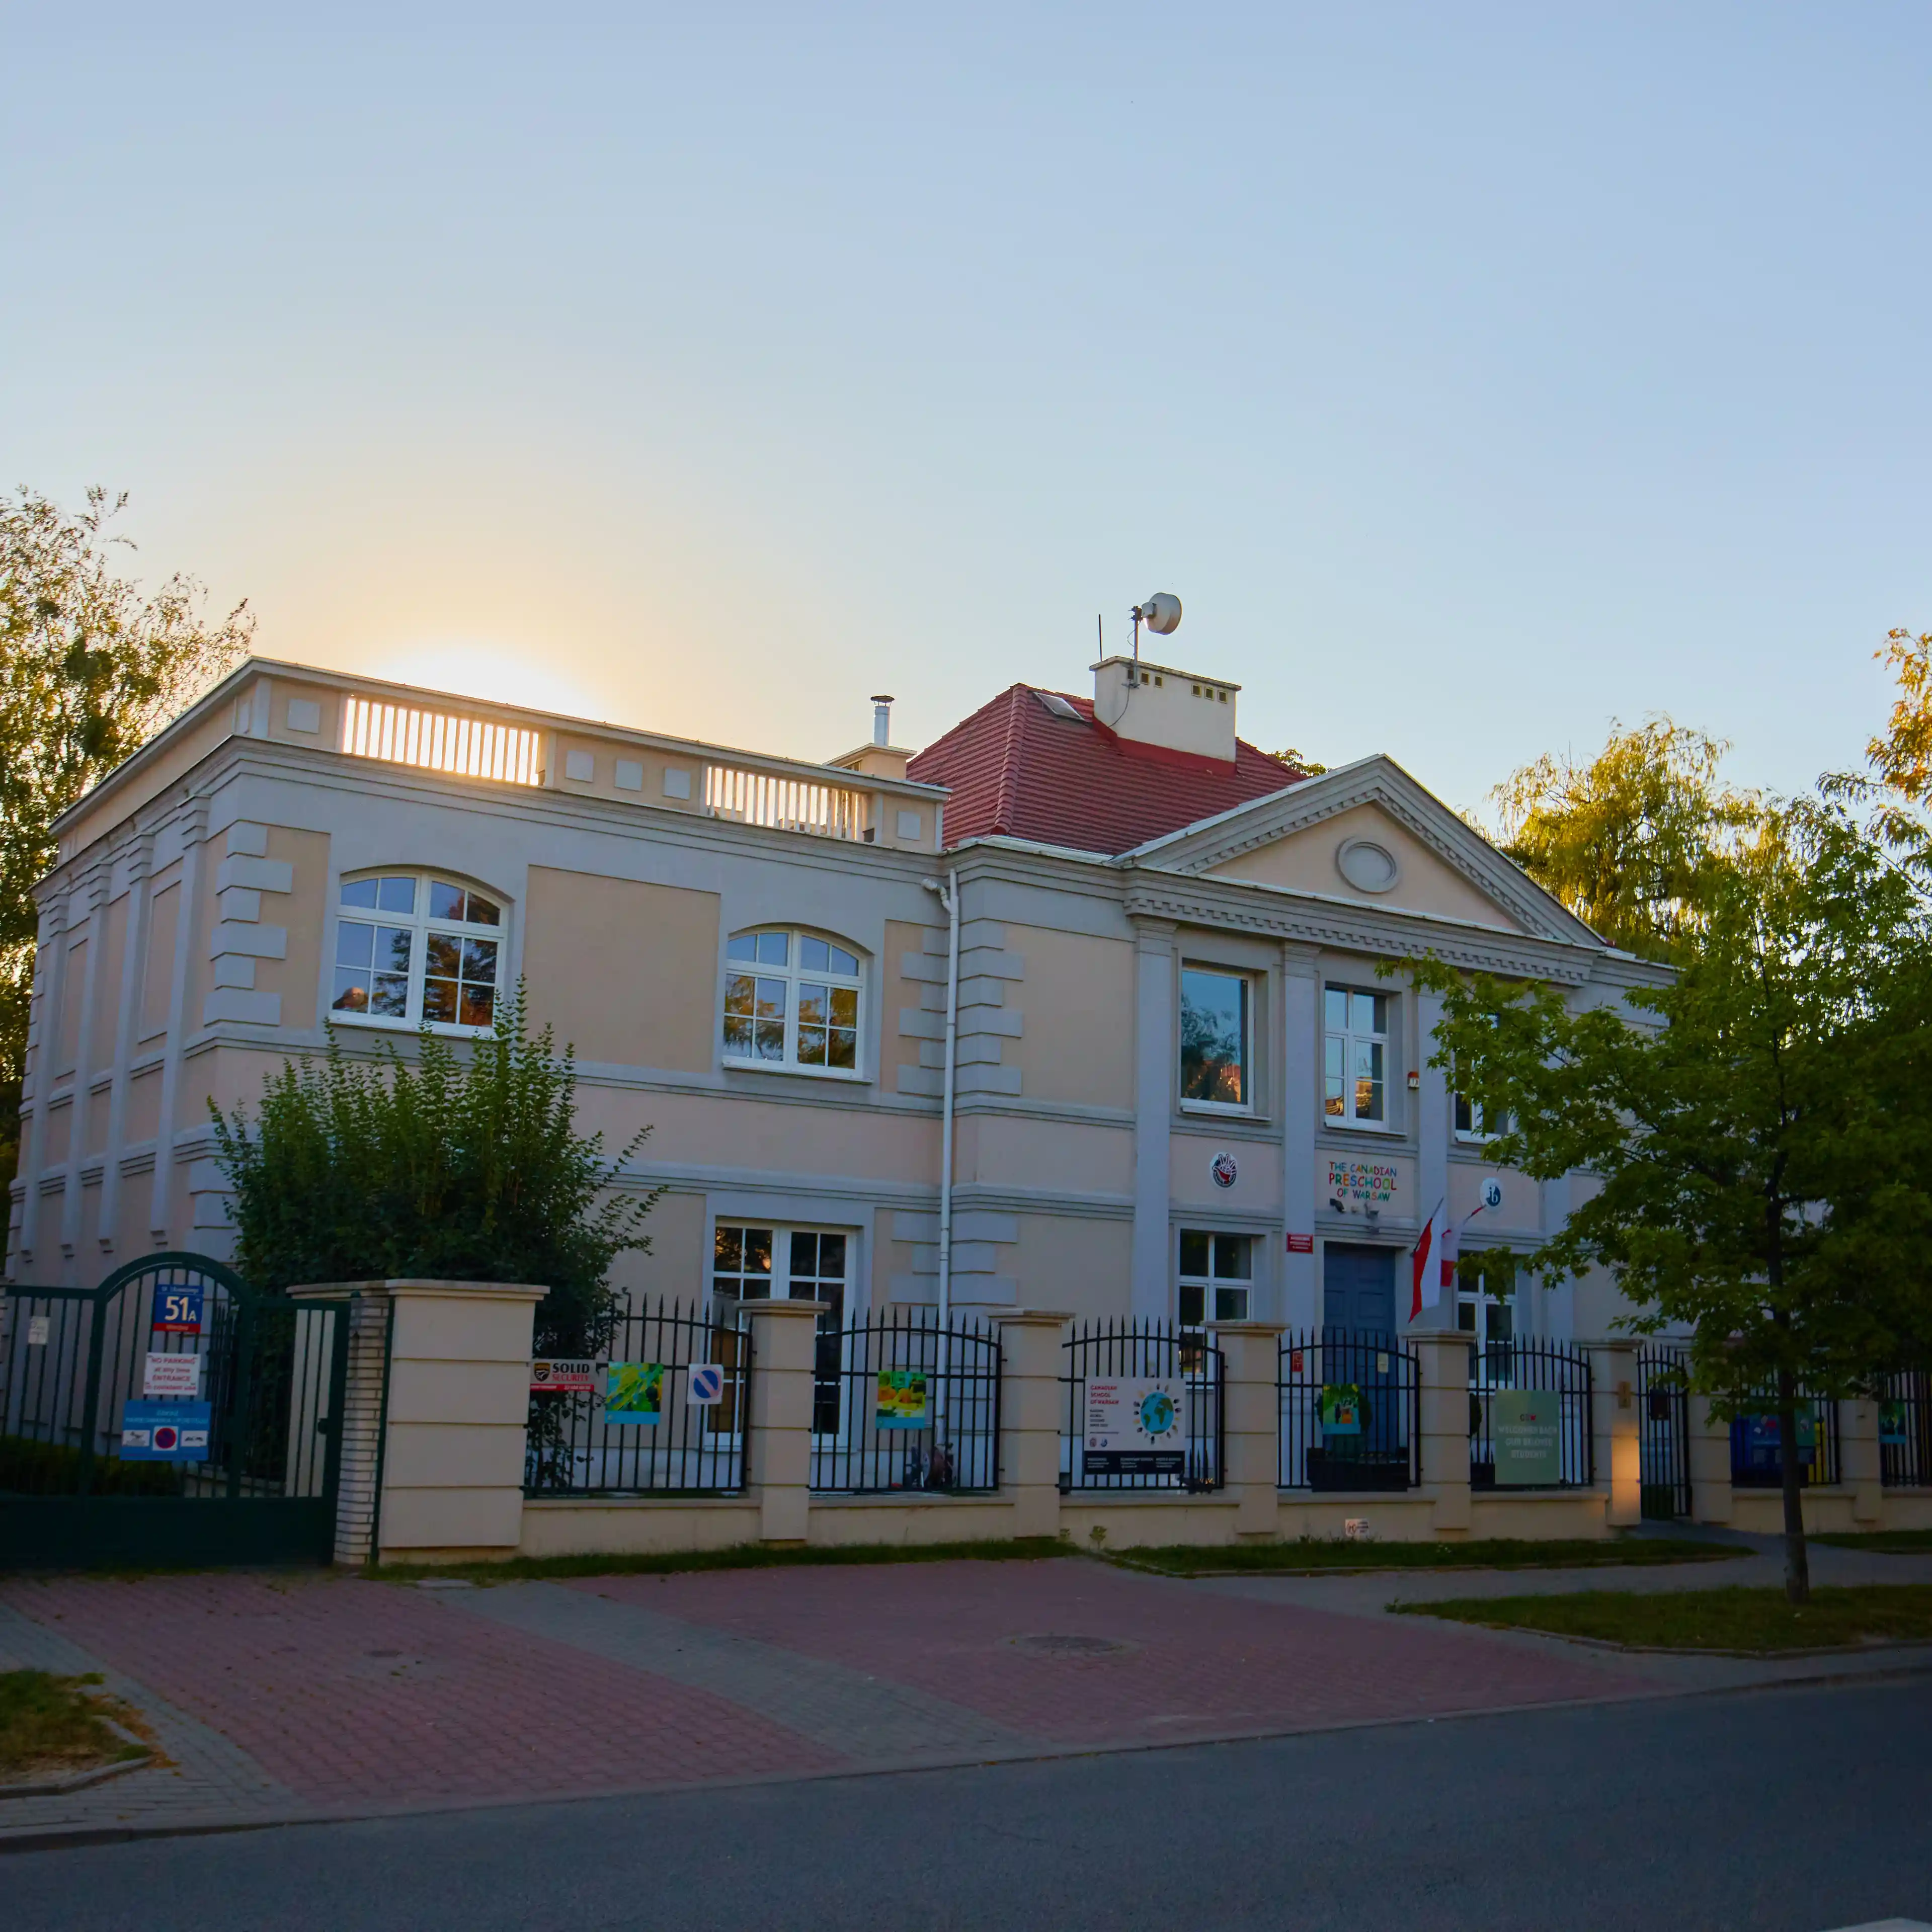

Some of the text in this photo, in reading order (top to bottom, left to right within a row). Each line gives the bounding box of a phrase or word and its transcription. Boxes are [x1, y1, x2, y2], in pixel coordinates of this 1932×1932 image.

[1329, 1161, 1397, 1177] THE CANADIAN
[1329, 1172, 1397, 1190] PRESCHOOL
[1337, 1187, 1390, 1201] OF WARSAW
[552, 1362, 590, 1374] SOLID
[552, 1374, 589, 1382] SECURITY
[1505, 1437, 1521, 1446] OUR
